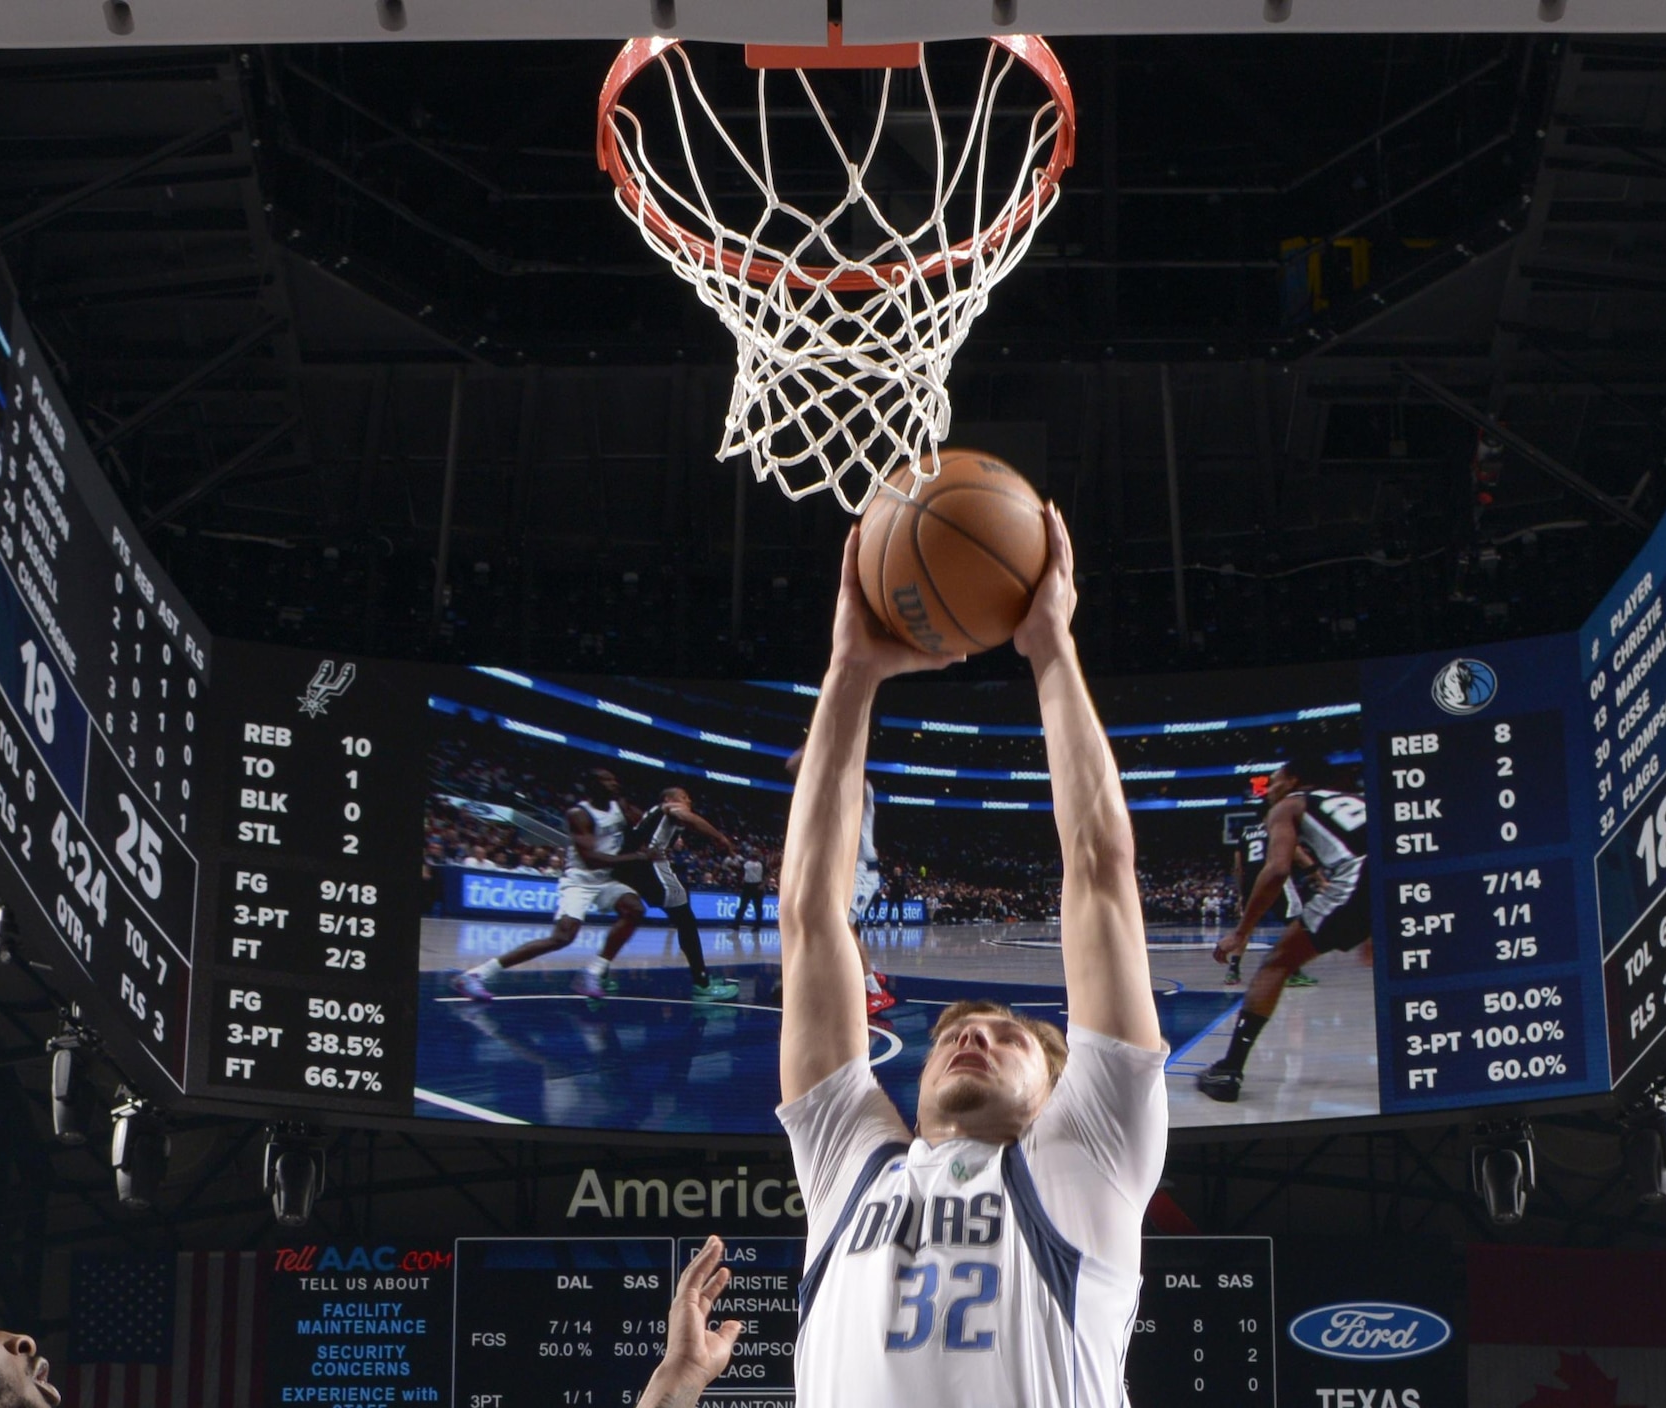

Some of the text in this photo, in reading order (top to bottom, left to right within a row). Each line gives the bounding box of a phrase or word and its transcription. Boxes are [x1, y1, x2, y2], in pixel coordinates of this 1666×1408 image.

[28, 414, 65, 494] HARPER
[24, 488, 57, 559] CASTLE
[32, 375, 204, 671] PLAYER PTS REB AST FLS
[20, 522, 58, 604] VASSELL
[18, 561, 76, 675] CHAMPAGNIE
[1610, 572, 1653, 636] PLAYER
[1590, 598, 1663, 701] 00 CHRISTIE
[19, 638, 57, 746] 18
[1593, 705, 1607, 732] 13
[1594, 693, 1650, 768] 30 CISSE
[243, 722, 372, 758] REB 10
[1391, 723, 1512, 757] REB 8
[242, 755, 358, 790] TO 1
[1391, 756, 1514, 790] TO 2
[1598, 774, 1613, 801] 31
[240, 788, 361, 822] BLK 0
[1394, 788, 1516, 822] BLK 0
[1599, 755, 1659, 837] 32 FLAGG
[115, 794, 163, 900] 25
[237, 821, 359, 855] STL 2
[1395, 821, 1518, 855] STL 0
[51, 810, 108, 927] 4:24
[235, 870, 378, 905] FG 9/18
[1399, 868, 1542, 905] FG 7/14
[233, 904, 376, 938] 3-PT 5/13
[1400, 903, 1531, 938] 3-PT 1/1
[232, 937, 366, 971] FT 2/3
[1402, 936, 1538, 971] FT 3/5
[1624, 947, 1653, 985] TOL
[229, 989, 385, 1025] FG 50.0%
[1405, 985, 1562, 1022] FG 50.0%
[1630, 1000, 1655, 1040] FLS
[227, 1023, 384, 1058] 3-PT 38.5%
[1406, 1019, 1565, 1056] 3-PT 100.0%
[225, 1056, 383, 1092] FT 66.7%
[1408, 1054, 1567, 1090] FT 60.0%
[299, 1277, 430, 1291] TELL US ABOUT
[557, 1274, 660, 1290] DAL SAS
[1165, 1274, 1254, 1289] DAL SAS
[322, 1302, 403, 1318] FACILITY
[885, 1262, 1001, 1353] 32
[297, 1319, 426, 1335] MAINTENANCE
[471, 1332, 507, 1347] FGS
[1321, 1311, 1421, 1350] Ford
[311, 1361, 411, 1377] CONCERNS
[317, 1344, 406, 1360] SECURITY
[282, 1386, 438, 1402] EXPERIENCE with
[470, 1394, 503, 1408] 3PT
